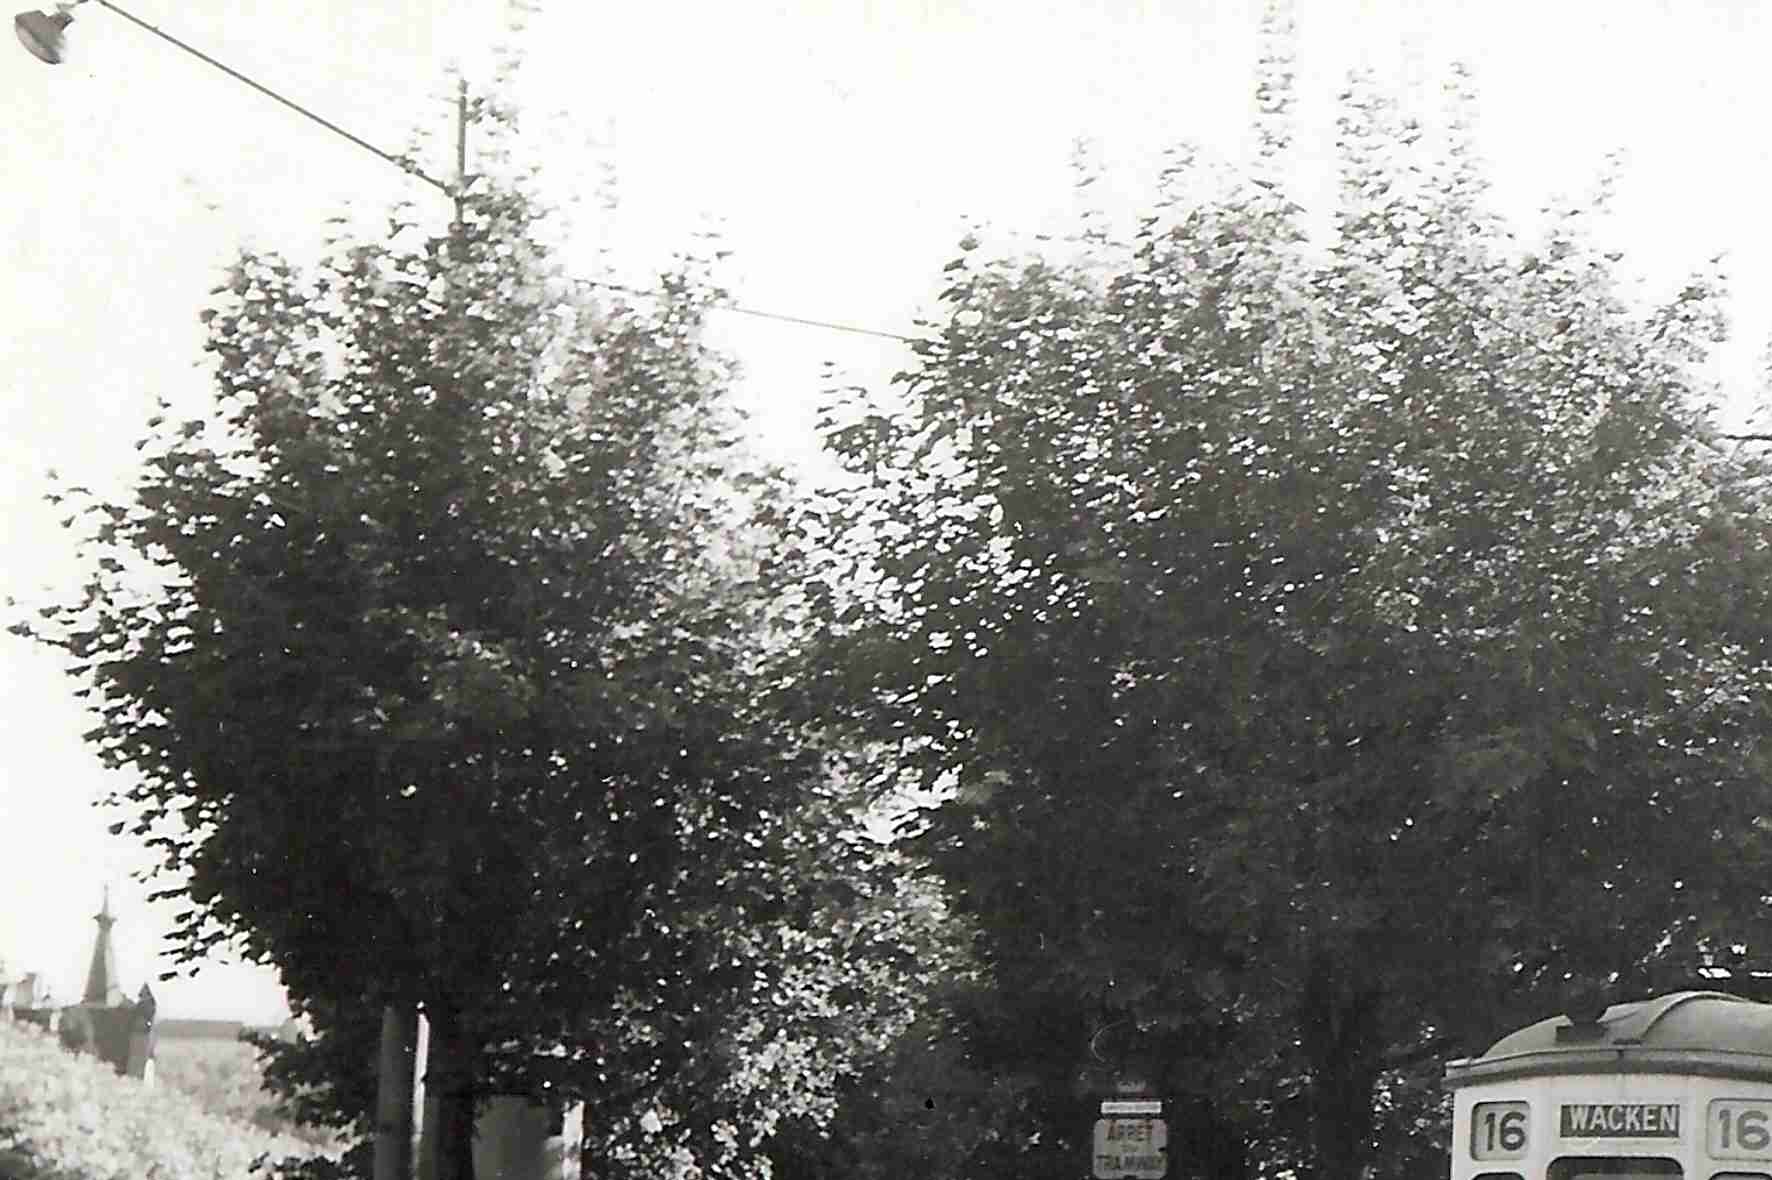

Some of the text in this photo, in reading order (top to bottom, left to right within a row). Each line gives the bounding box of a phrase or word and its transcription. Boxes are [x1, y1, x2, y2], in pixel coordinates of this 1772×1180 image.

[1484, 1111, 1526, 1151] 16
[1569, 1105, 1677, 1132] WACKEN
[1718, 1109, 1771, 1151] 16
